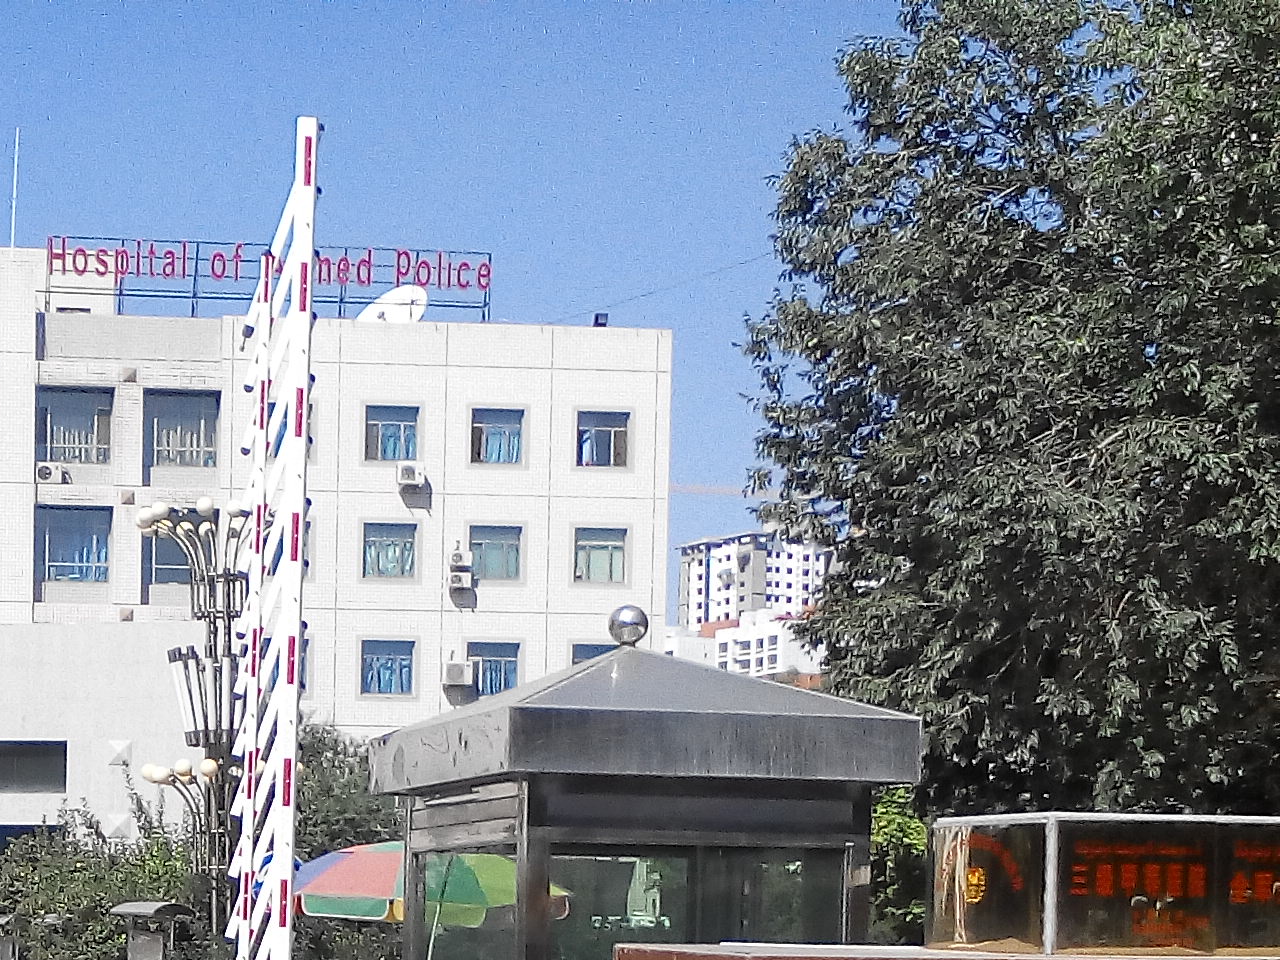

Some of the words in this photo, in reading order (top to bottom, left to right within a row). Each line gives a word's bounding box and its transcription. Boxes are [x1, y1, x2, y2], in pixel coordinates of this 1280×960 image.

[47, 236, 189, 280] Hospital
[211, 242, 244, 281] of
[395, 249, 493, 291] Police
